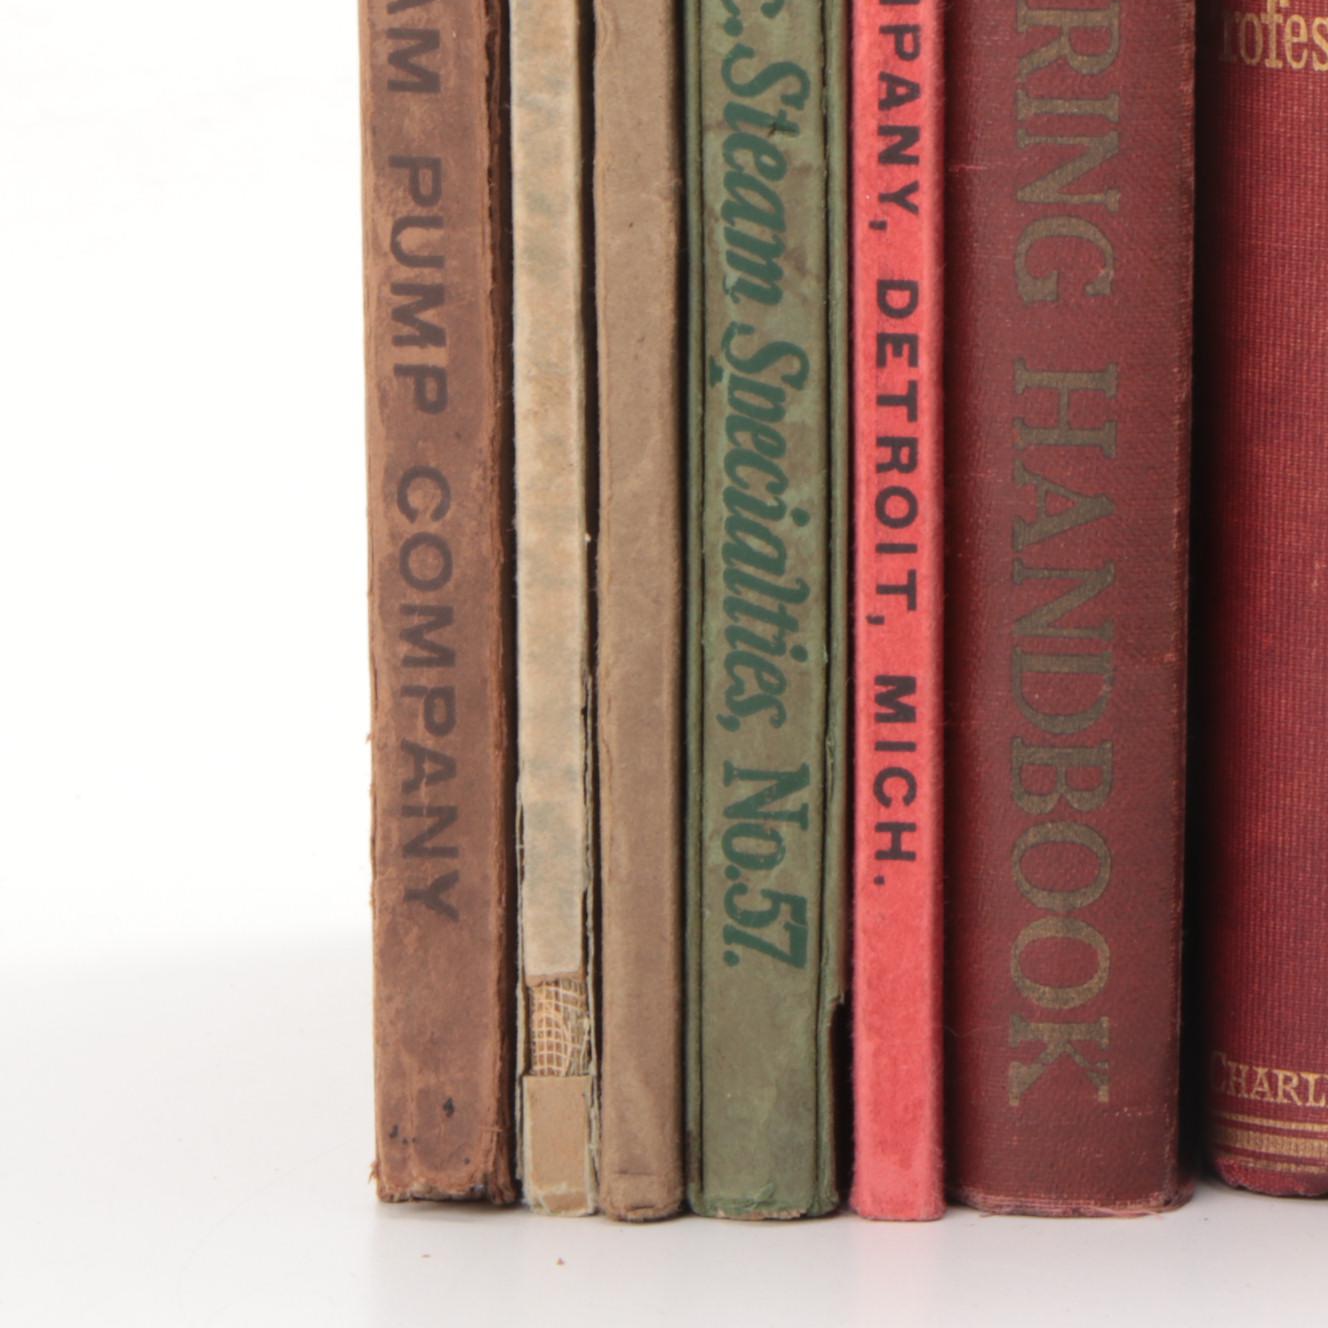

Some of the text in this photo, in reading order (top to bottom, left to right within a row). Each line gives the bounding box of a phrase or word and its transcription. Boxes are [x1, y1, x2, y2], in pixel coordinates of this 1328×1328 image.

[388, 154, 449, 414] PUMP
[717, 43, 811, 306] Steam
[709, 321, 811, 732] Specialties,
[866, 279, 919, 628] DETROIT,
[396, 466, 460, 924] COMPANY
[873, 674, 918, 887] MICH.
[1007, 358, 1117, 1107] HANDBOOK
